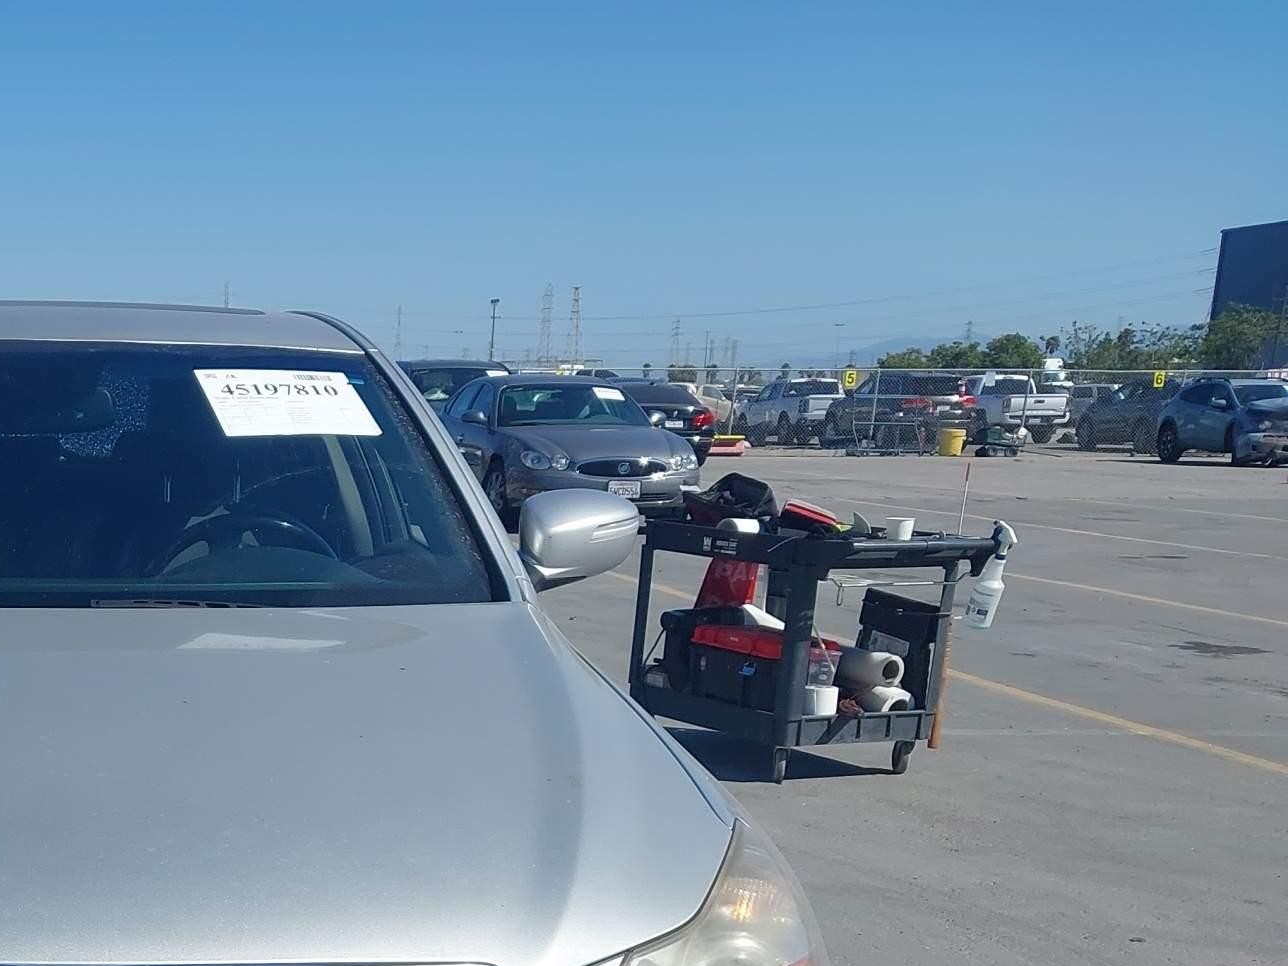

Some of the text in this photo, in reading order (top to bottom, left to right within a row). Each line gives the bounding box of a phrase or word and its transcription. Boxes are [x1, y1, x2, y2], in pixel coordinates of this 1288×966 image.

[847, 373, 855, 384] 5
[1155, 373, 1163, 385] 6
[220, 383, 338, 396] 45197810
